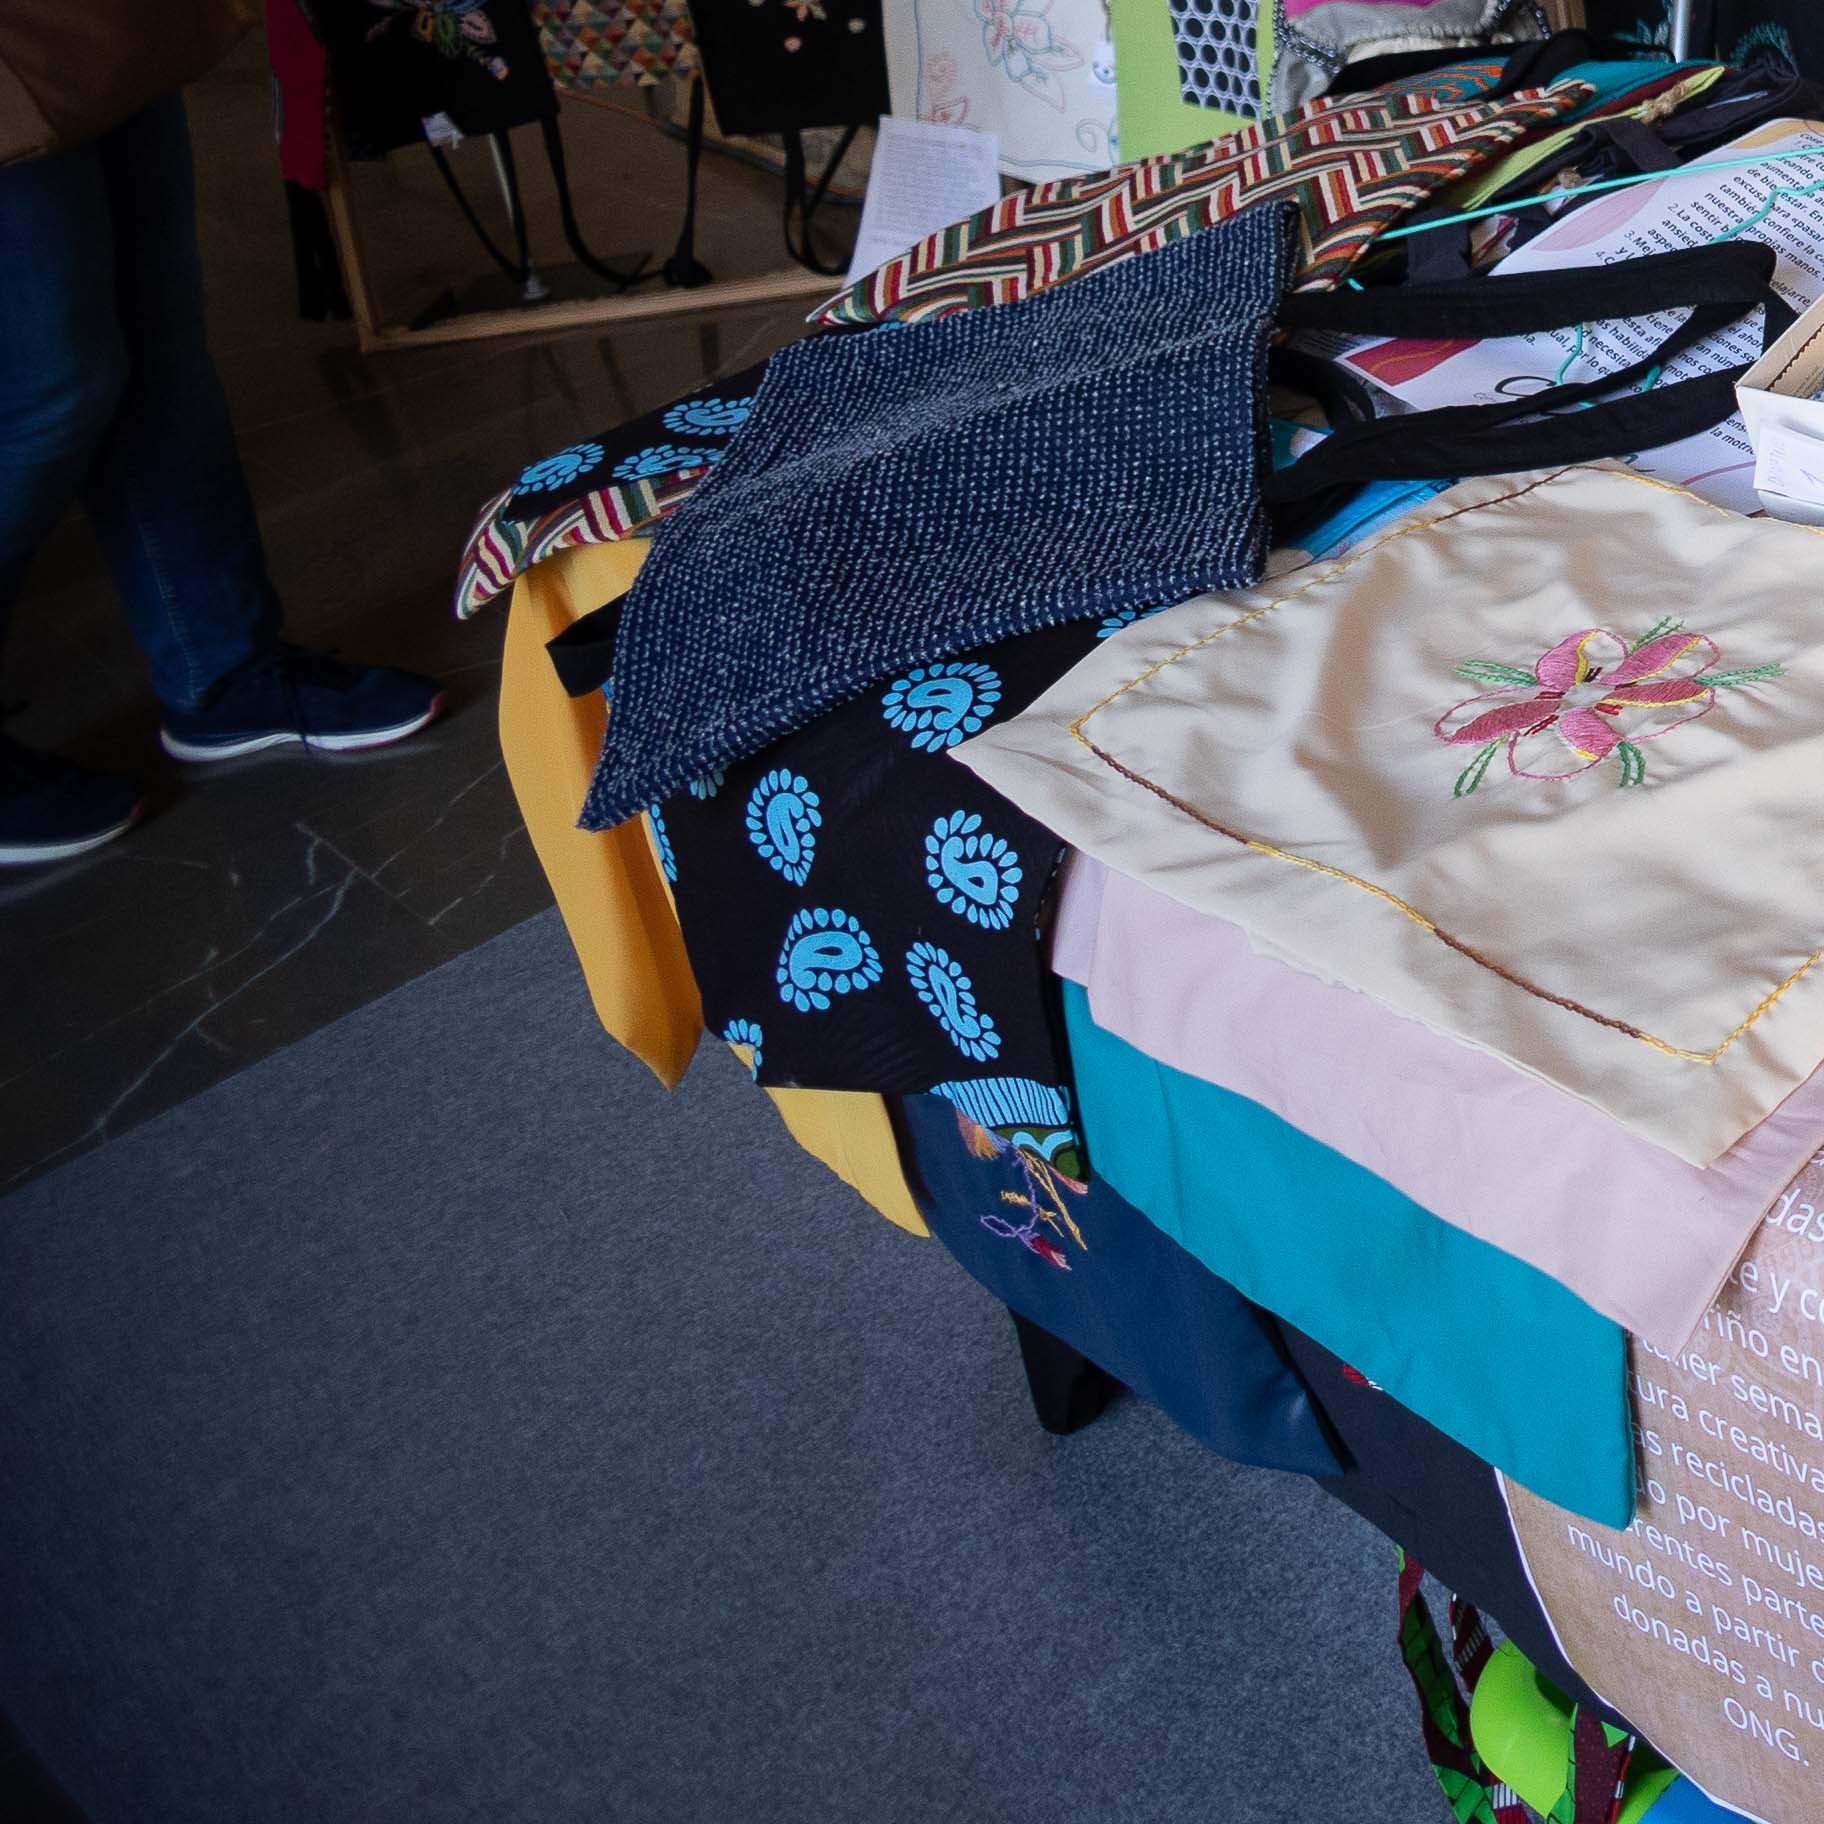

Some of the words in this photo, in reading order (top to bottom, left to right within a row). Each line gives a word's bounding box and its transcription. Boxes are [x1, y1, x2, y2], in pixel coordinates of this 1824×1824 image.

[1769, 1270, 1791, 1314] y
[1780, 1342, 1824, 1388] en
[1677, 1494, 1730, 1538] por
[1567, 1523, 1677, 1599] mundo
[1685, 1590, 1703, 1616] a
[1712, 1604, 1801, 1670] partir
[1613, 1593, 1747, 1685] donadas
[1755, 1676, 1773, 1700] a
[1723, 1696, 1811, 1767] ONG.
